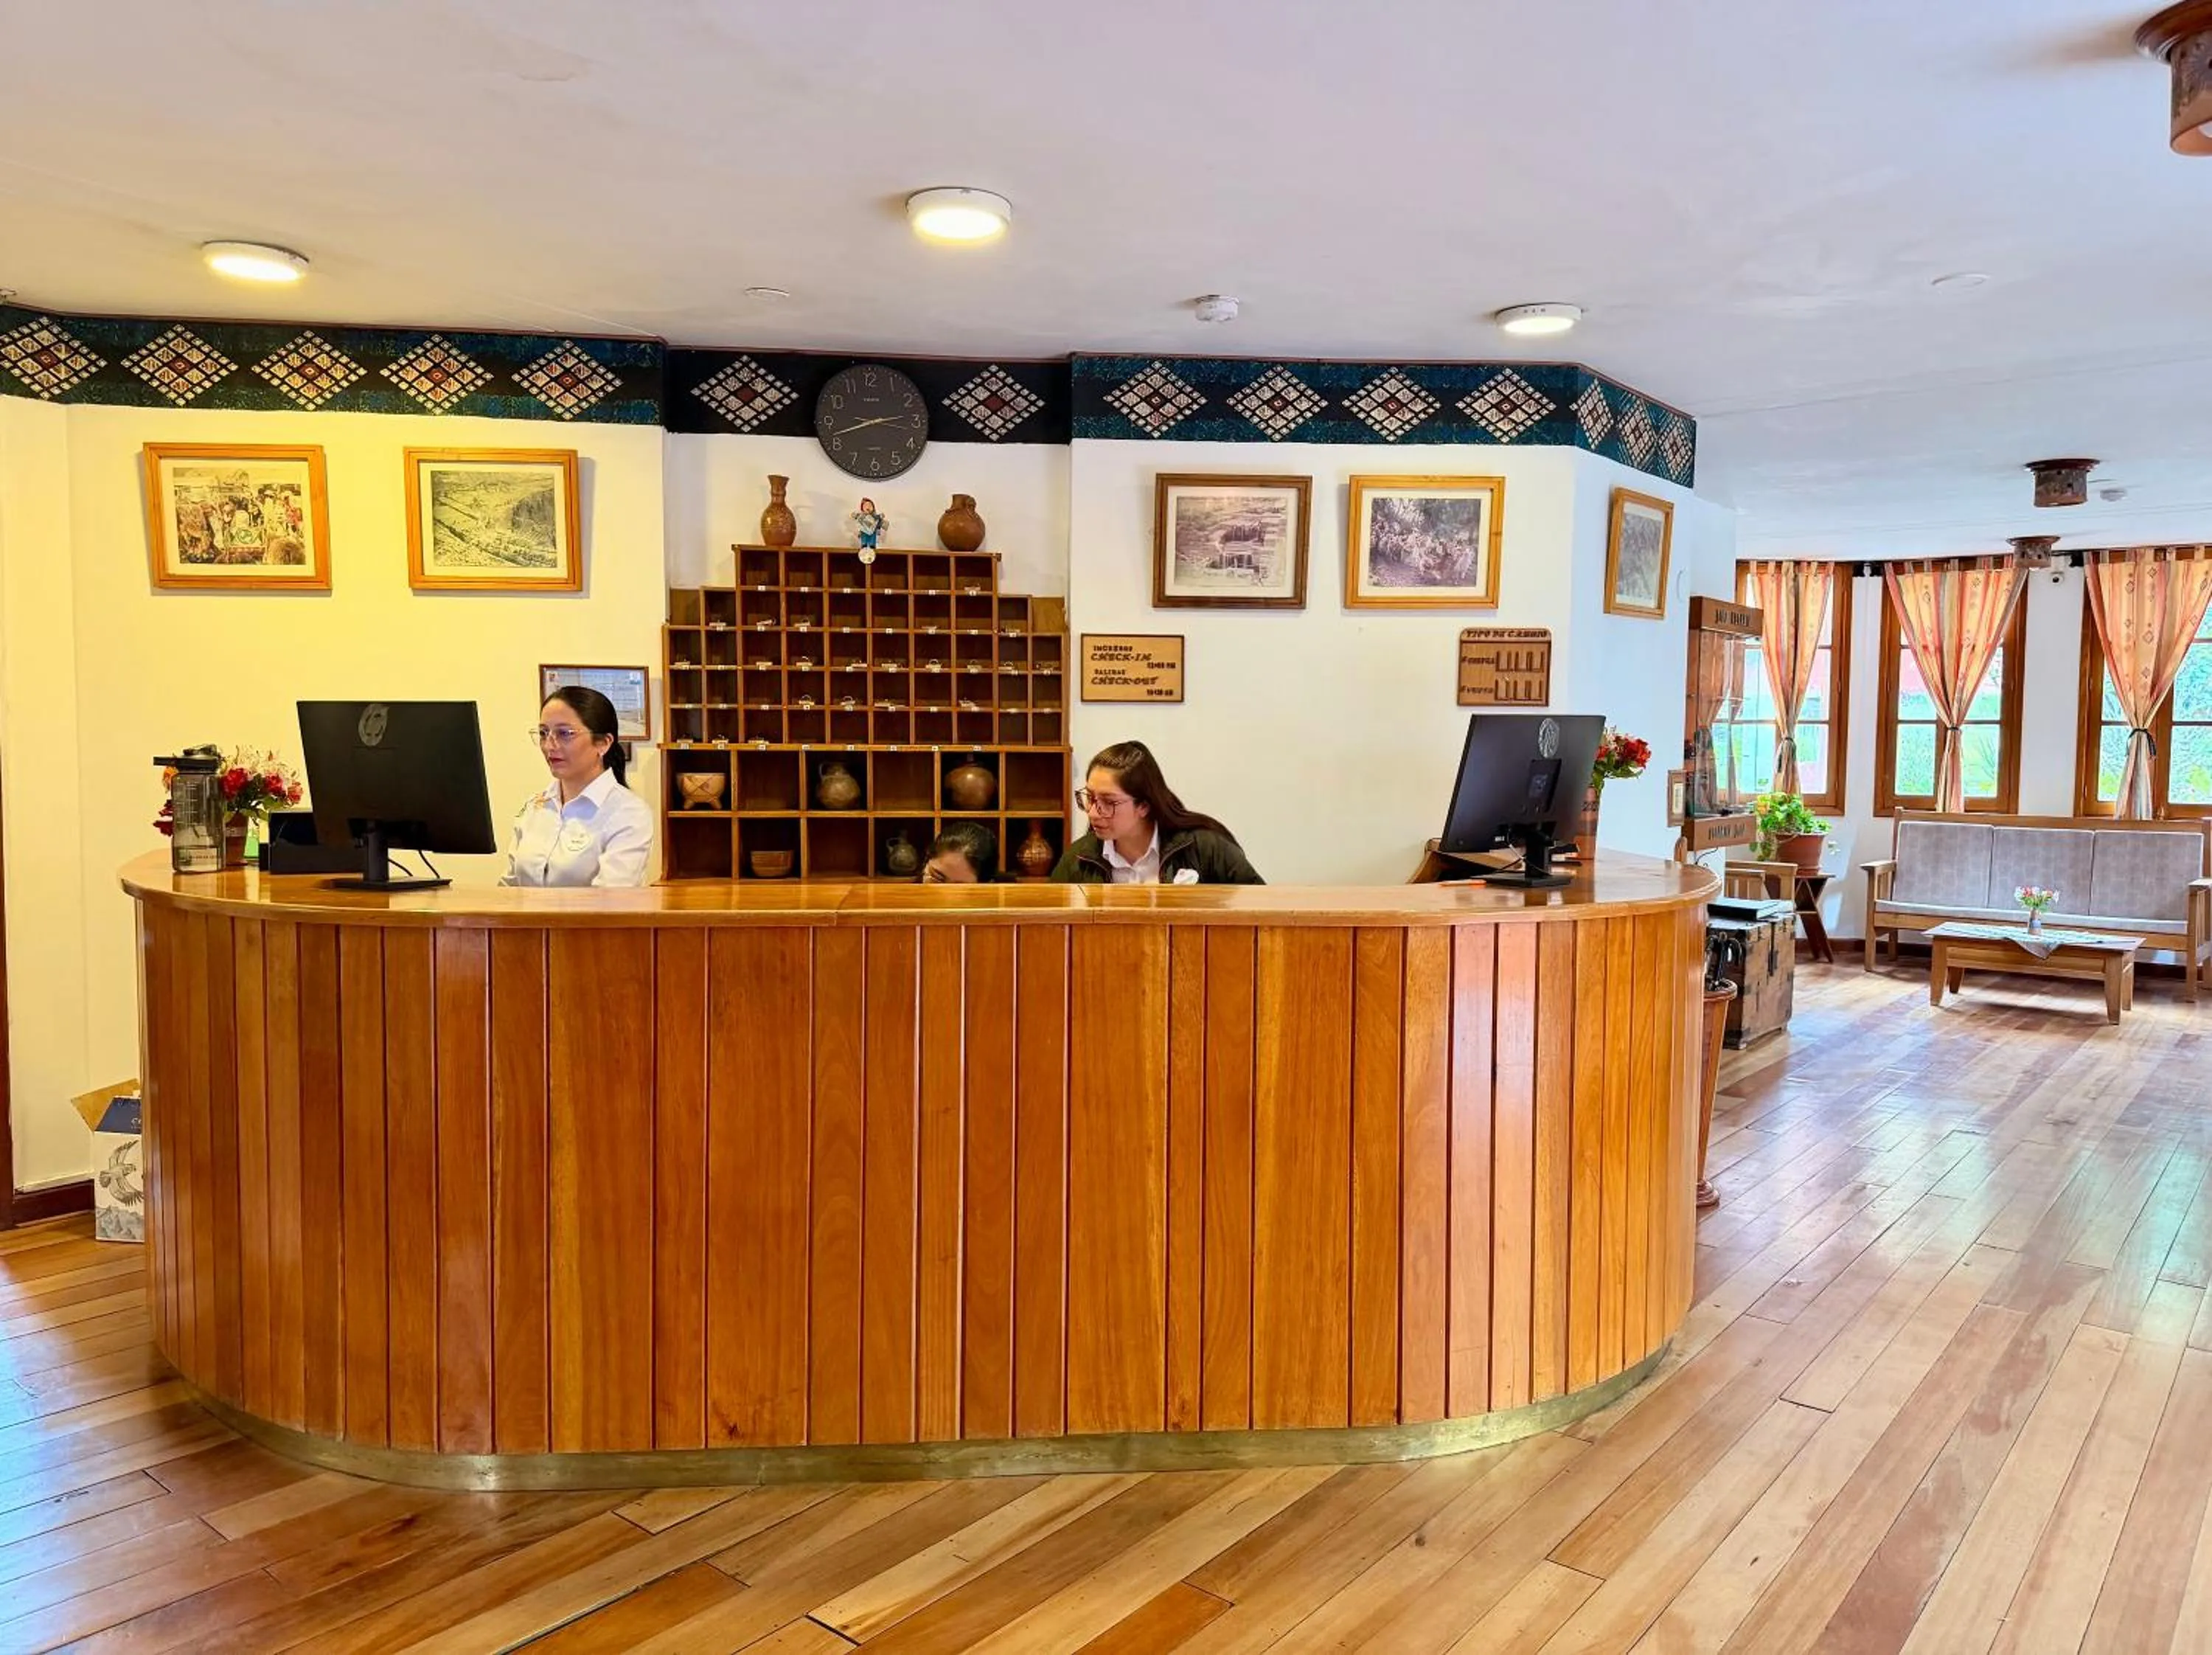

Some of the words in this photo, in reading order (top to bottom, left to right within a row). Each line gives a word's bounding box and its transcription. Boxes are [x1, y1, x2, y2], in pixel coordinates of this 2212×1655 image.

[846, 378, 857, 394] 11
[863, 372, 877, 387] 12
[888, 376, 895, 392] 1
[830, 395, 844, 409] 10
[903, 393, 914, 407] 2
[824, 415, 834, 429] 9
[911, 414, 921, 429] 3
[832, 437, 843, 451] 8
[905, 436, 916, 449] 4
[849, 452, 858, 465] 7
[870, 457, 880, 471] 6
[891, 451, 902, 465] 5
[1091, 653, 1152, 662] CHECK-IN
[1091, 676, 1159, 685] CHECK-OUT
